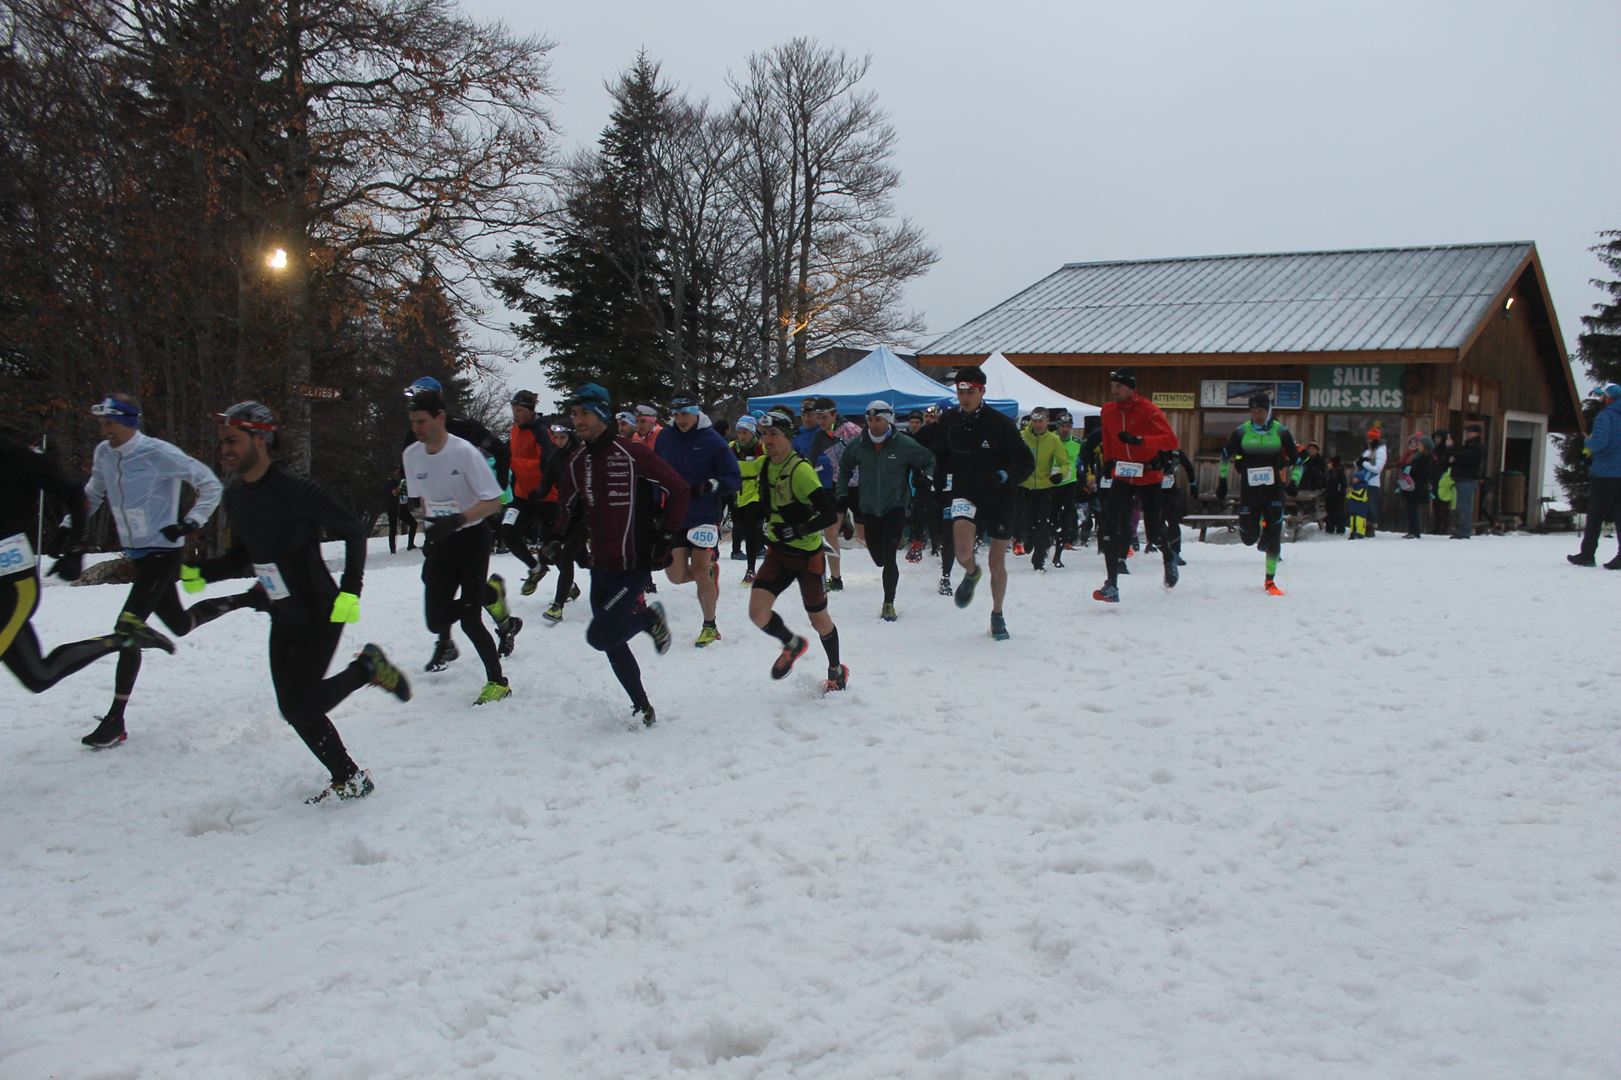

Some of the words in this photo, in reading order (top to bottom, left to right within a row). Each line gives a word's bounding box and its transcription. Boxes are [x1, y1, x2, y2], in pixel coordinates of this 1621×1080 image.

[1333, 367, 1380, 386] SALLE
[1153, 393, 1194, 402] ATTENTION
[1309, 388, 1402, 408] HORS-SACS
[692, 531, 714, 542] 450
